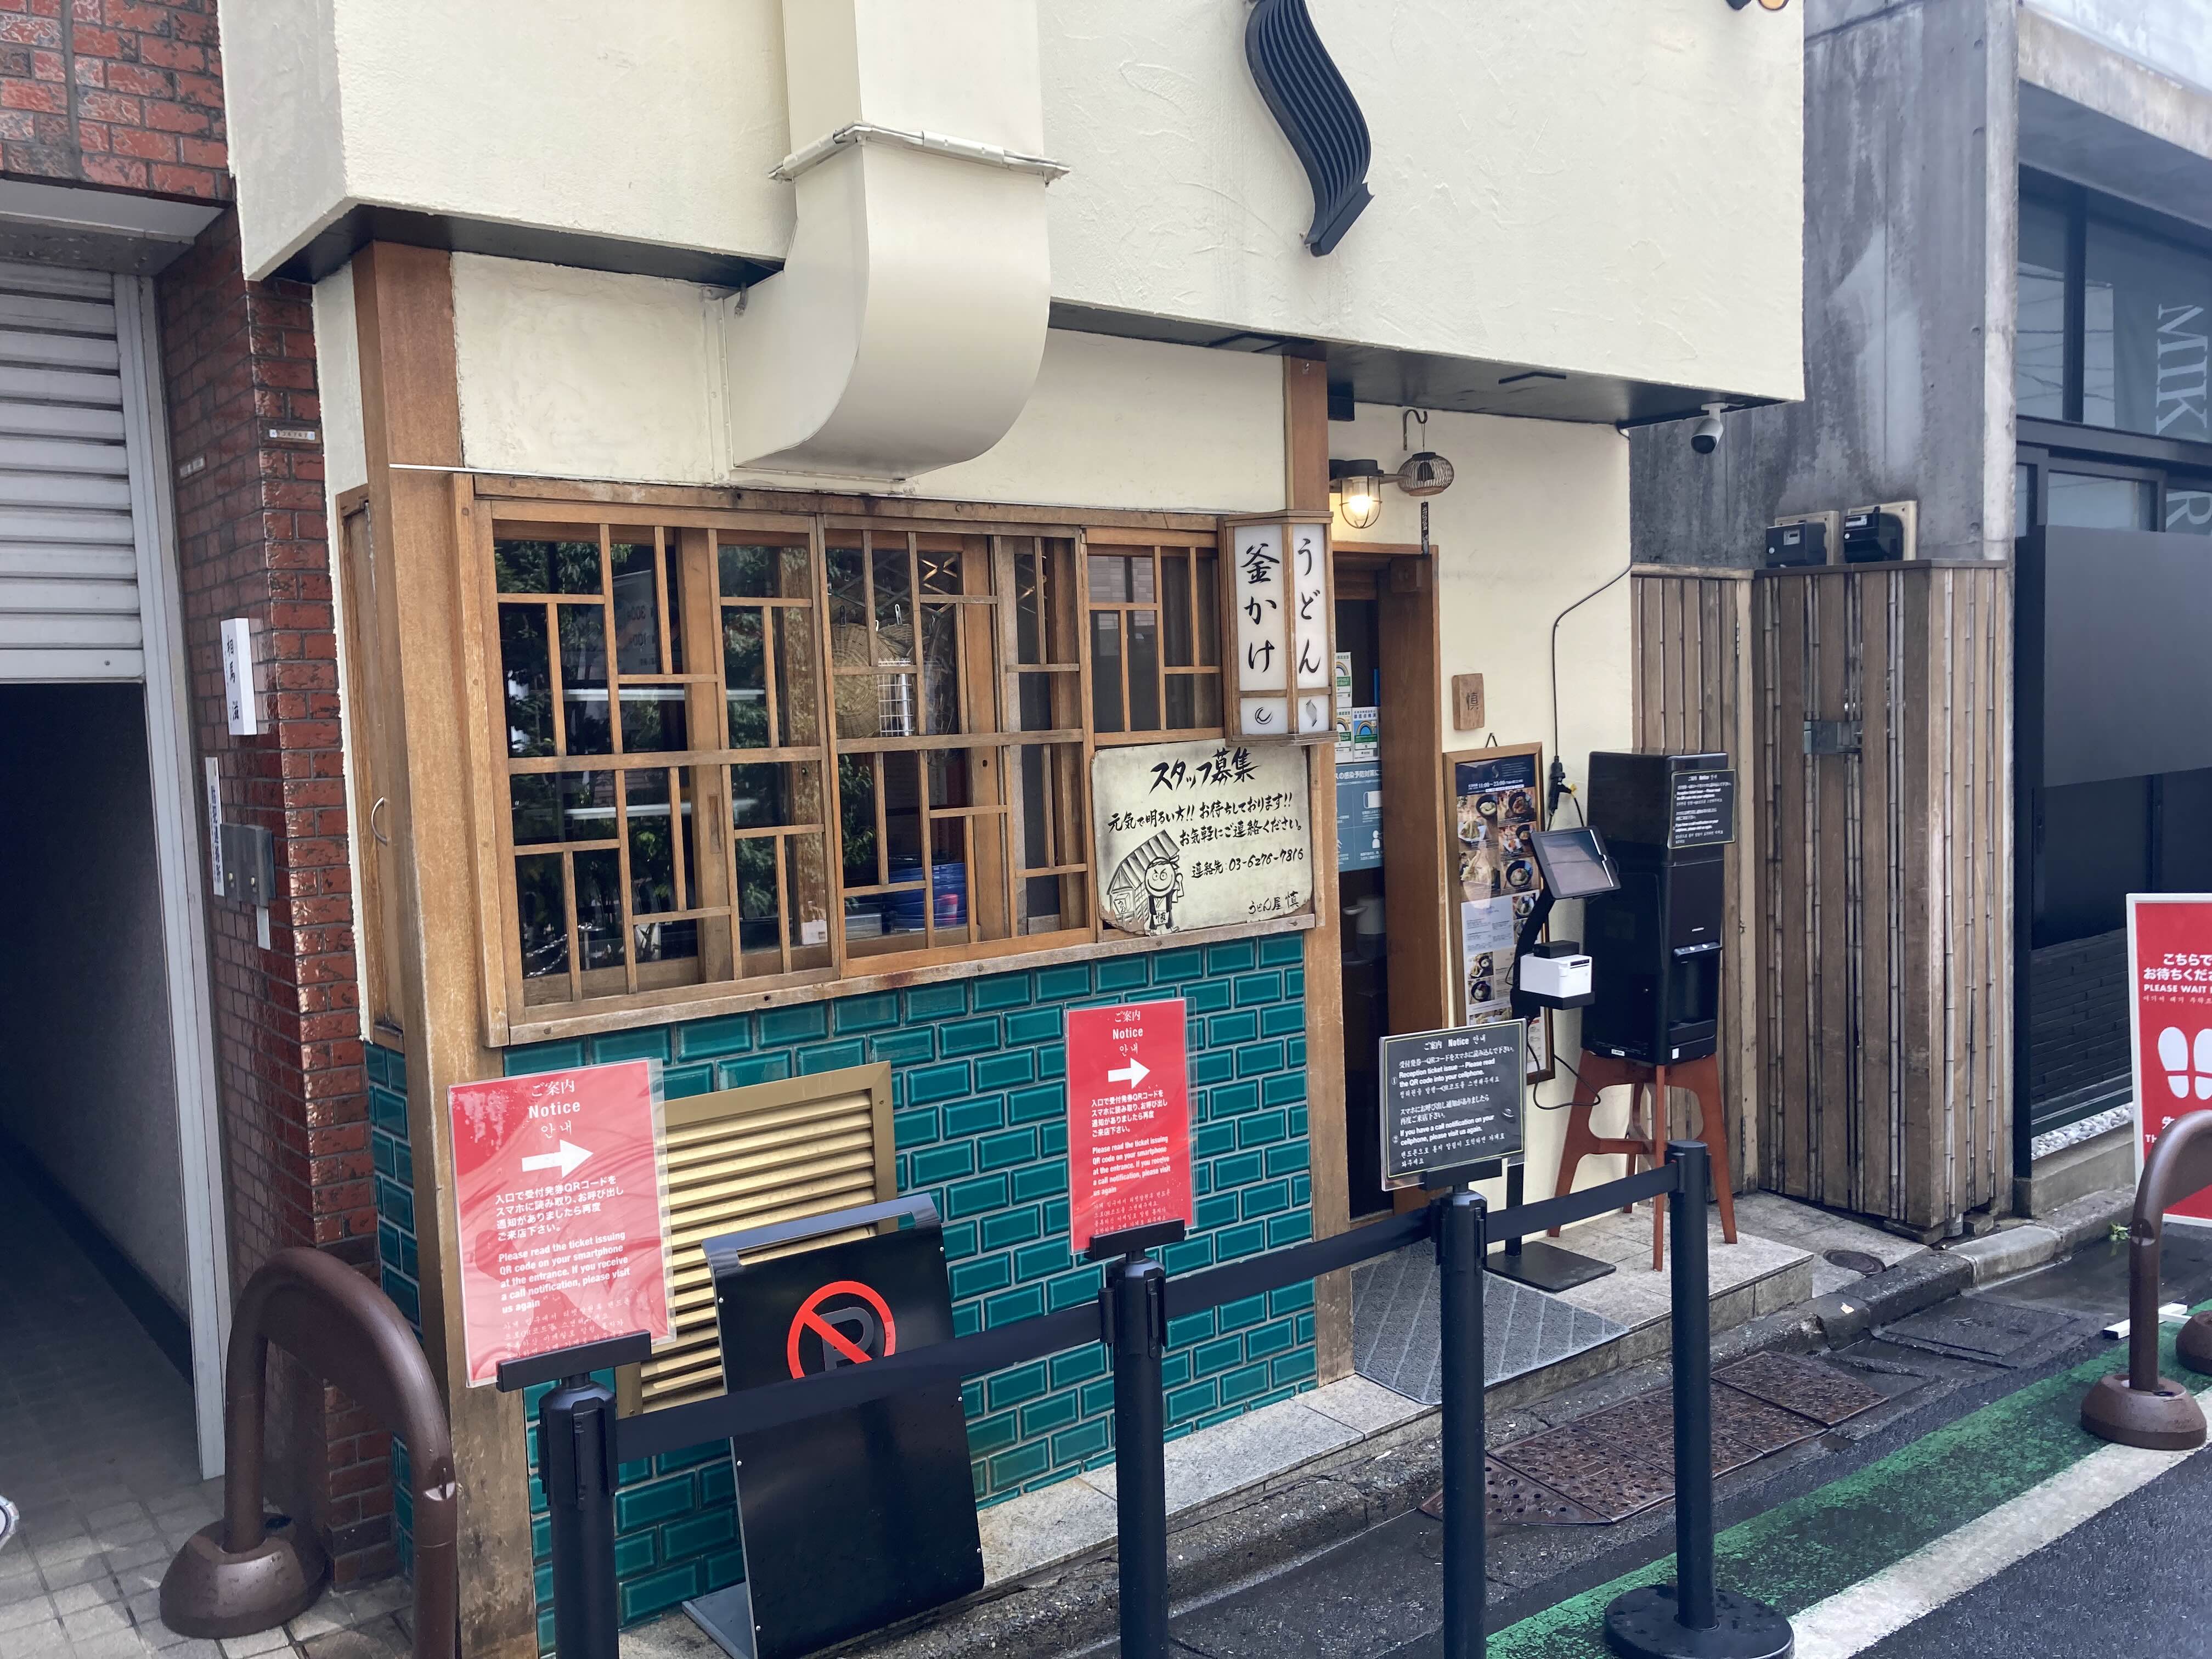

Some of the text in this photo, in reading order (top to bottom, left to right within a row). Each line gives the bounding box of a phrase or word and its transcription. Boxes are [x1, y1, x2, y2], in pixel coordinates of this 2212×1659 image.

[1240, 543, 1280, 673] 釜かけ
[1297, 538, 1321, 674] うどん
[1149, 746, 1261, 794] スタッフ募集
[1179, 816, 1302, 846] お気軽にご連絡ください。
[1249, 896, 1282, 915] うどん屋
[2144, 984, 2177, 992] PLEASE
[2181, 985, 2207, 994] WAIT
[1115, 1009, 1141, 1023] ご案内
[1113, 1027, 1143, 1040] Notice
[1448, 1037, 1469, 1047] Notice
[1120, 1042, 1138, 1057] 안내
[1399, 1069, 1426, 1079] Reception
[1427, 1065, 1443, 1074] ticket
[1445, 1074, 1457, 1082] your
[532, 1079, 575, 1097] ご案内
[528, 1101, 580, 1119] Notice
[541, 1120, 572, 1138] 안내
[1404, 1129, 1415, 1138] you
[1445, 1118, 1474, 1128] notification
[1482, 1114, 1495, 1122] your
[1092, 1146, 1110, 1154] Please
[1111, 1142, 1124, 1150] read
[1135, 1138, 1149, 1147] ticket
[1429, 1132, 1447, 1142] please
[1092, 1157, 1100, 1165] QR
[1124, 1152, 1136, 1160] your
[1137, 1146, 1167, 1157] smartphone
[1110, 1163, 1135, 1172] entrance.
[1141, 1160, 1150, 1168] you
[1152, 1156, 1170, 1165] receive
[1098, 1176, 1108, 1185] call
[1109, 1171, 1141, 1183] notification,
[1142, 1168, 1159, 1178] please
[1160, 1165, 1171, 1173] visit
[1102, 1186, 1116, 1195] again
[499, 1232, 625, 1262] Please read the ticket issuing
[500, 1245, 623, 1276] QR code on your smartphone
[500, 1256, 628, 1288] at the entrance. If you receive
[510, 1286, 526, 1299] call
[528, 1279, 580, 1296] notification,
[582, 1273, 610, 1286] please
[612, 1267, 630, 1278] visit
[502, 1299, 540, 1314] us again
